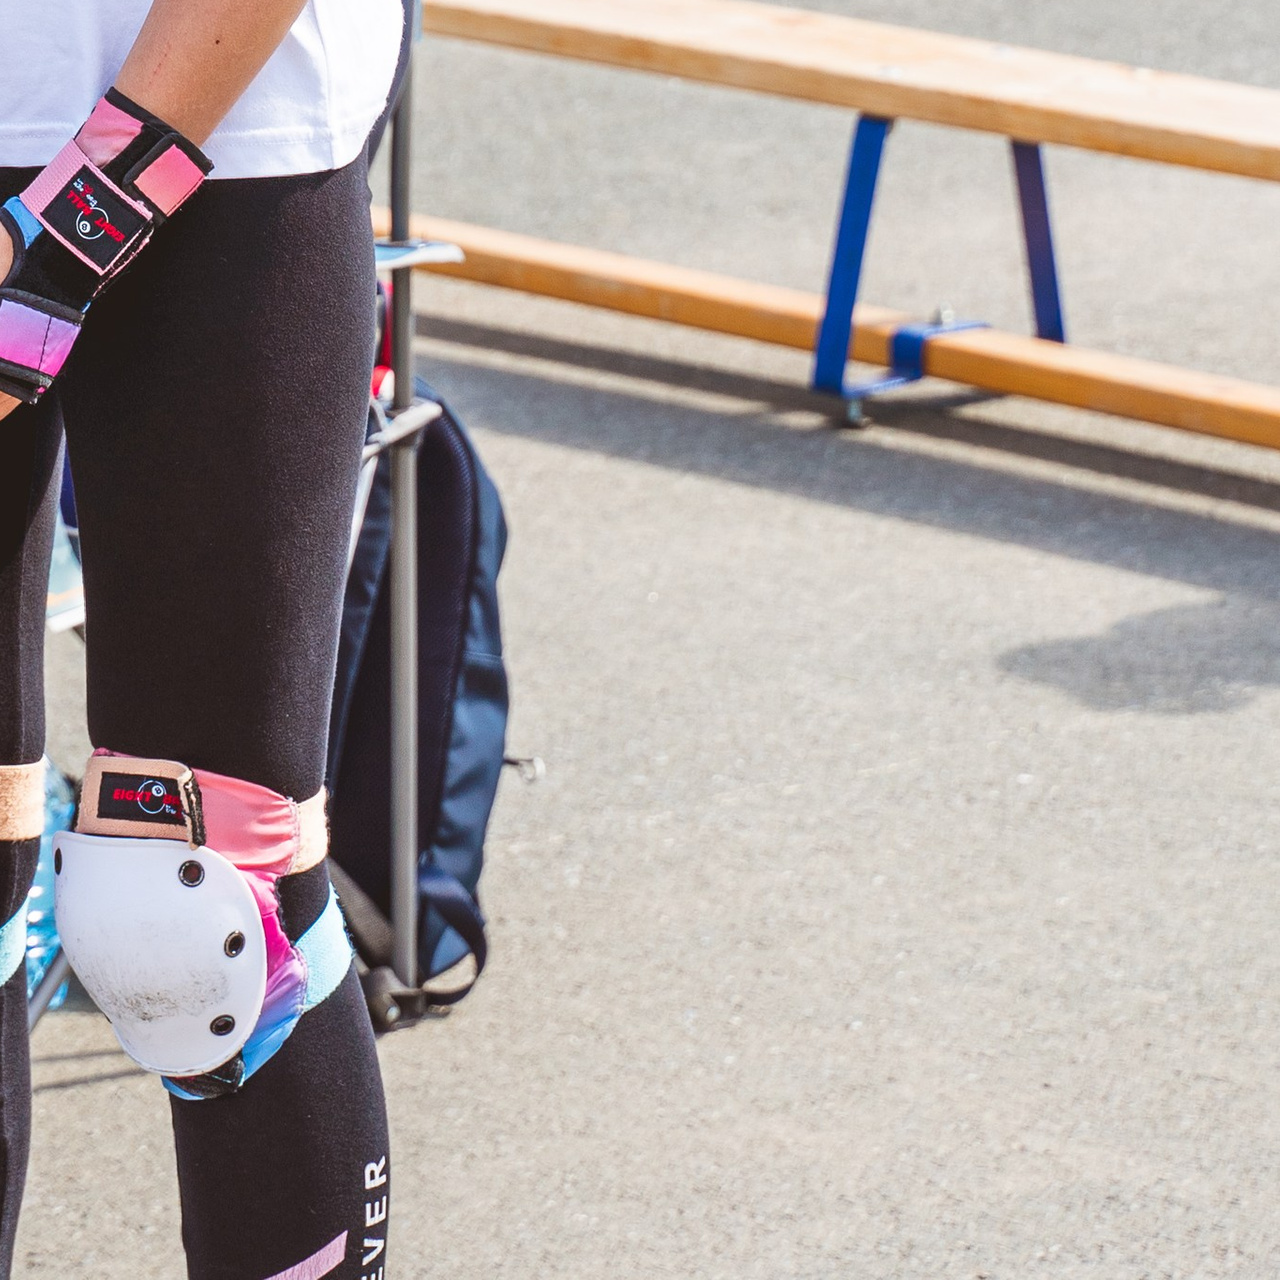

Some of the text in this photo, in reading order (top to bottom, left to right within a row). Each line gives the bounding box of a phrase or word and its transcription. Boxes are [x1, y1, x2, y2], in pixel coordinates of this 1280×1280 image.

[66, 190, 93, 216] BALL
[94, 217, 126, 242] EIGHT
[112, 788, 152, 802] EIGHT
